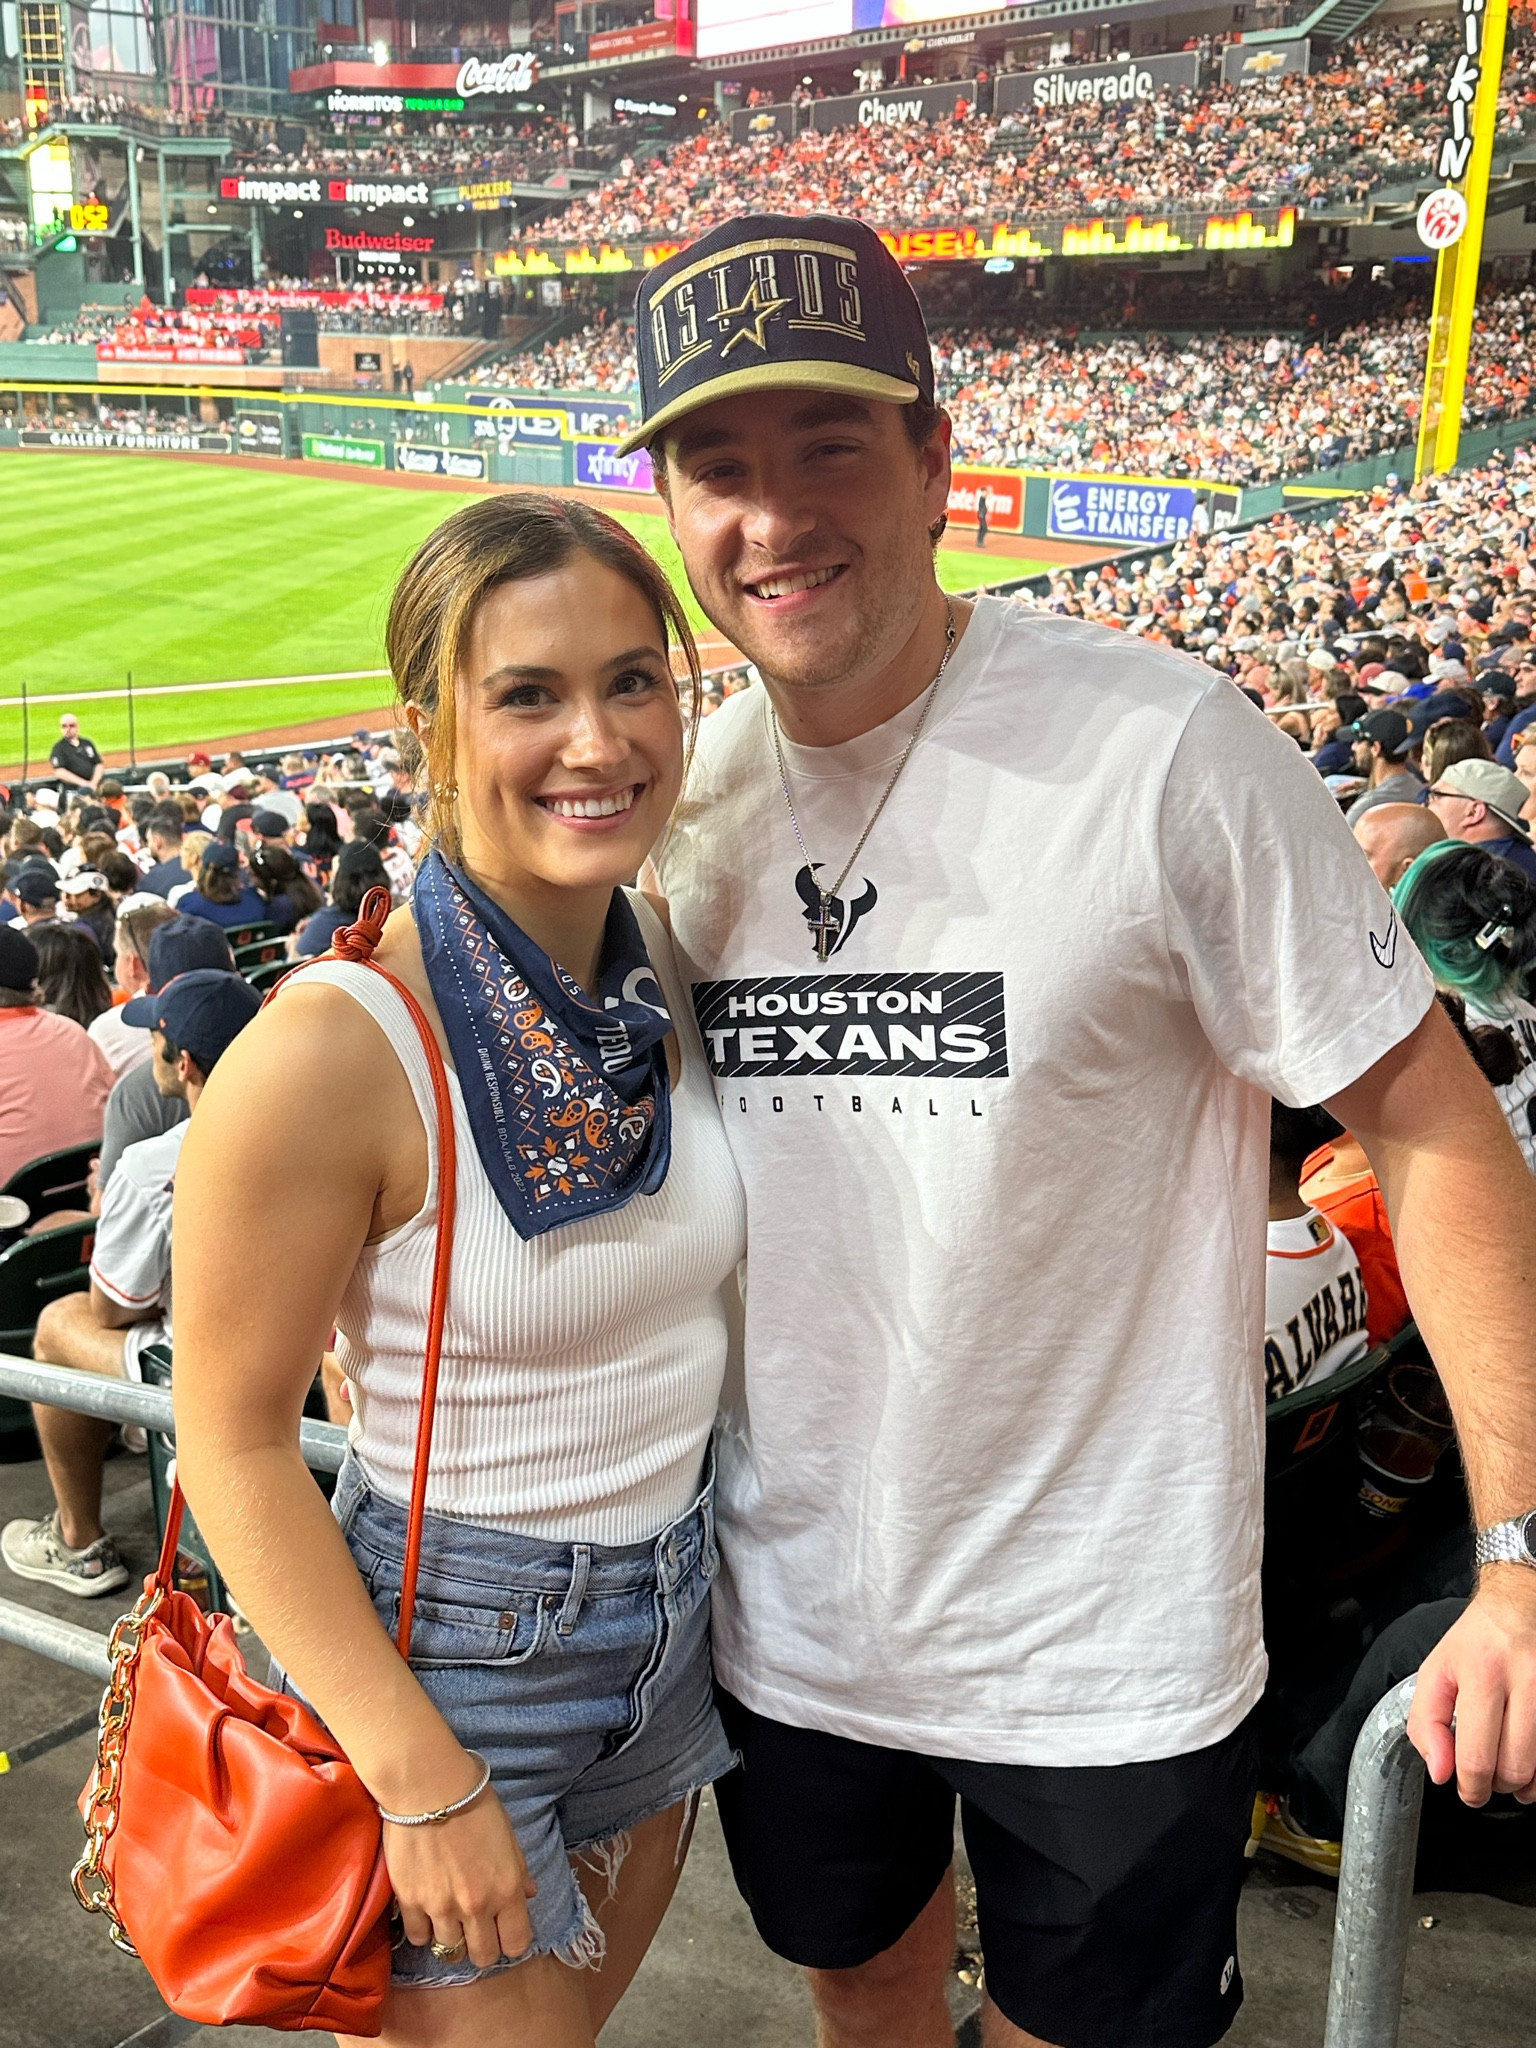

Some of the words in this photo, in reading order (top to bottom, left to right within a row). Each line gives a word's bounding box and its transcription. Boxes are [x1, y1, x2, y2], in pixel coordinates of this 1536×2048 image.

[1033, 65, 1153, 107] Silverado
[1439, 0, 1484, 178] IKIN
[328, 95, 403, 112] HORNITOS
[858, 98, 923, 128] Chevy
[238, 175, 321, 204] impact
[345, 178, 429, 207] impact
[325, 228, 435, 252] Budweiser
[651, 254, 863, 377] ASTROS
[50, 432, 113, 446] GALLERY
[116, 434, 200, 449] FURNITURE
[1086, 487, 1171, 515] ENERGY
[1086, 511, 1189, 540] TRANSFER
[728, 990, 943, 1018] HOUSTON
[705, 1024, 990, 1063] TEXANS
[477, 1047, 493, 1072] DRINK
[720, 1095, 982, 1116] OOTBALL
